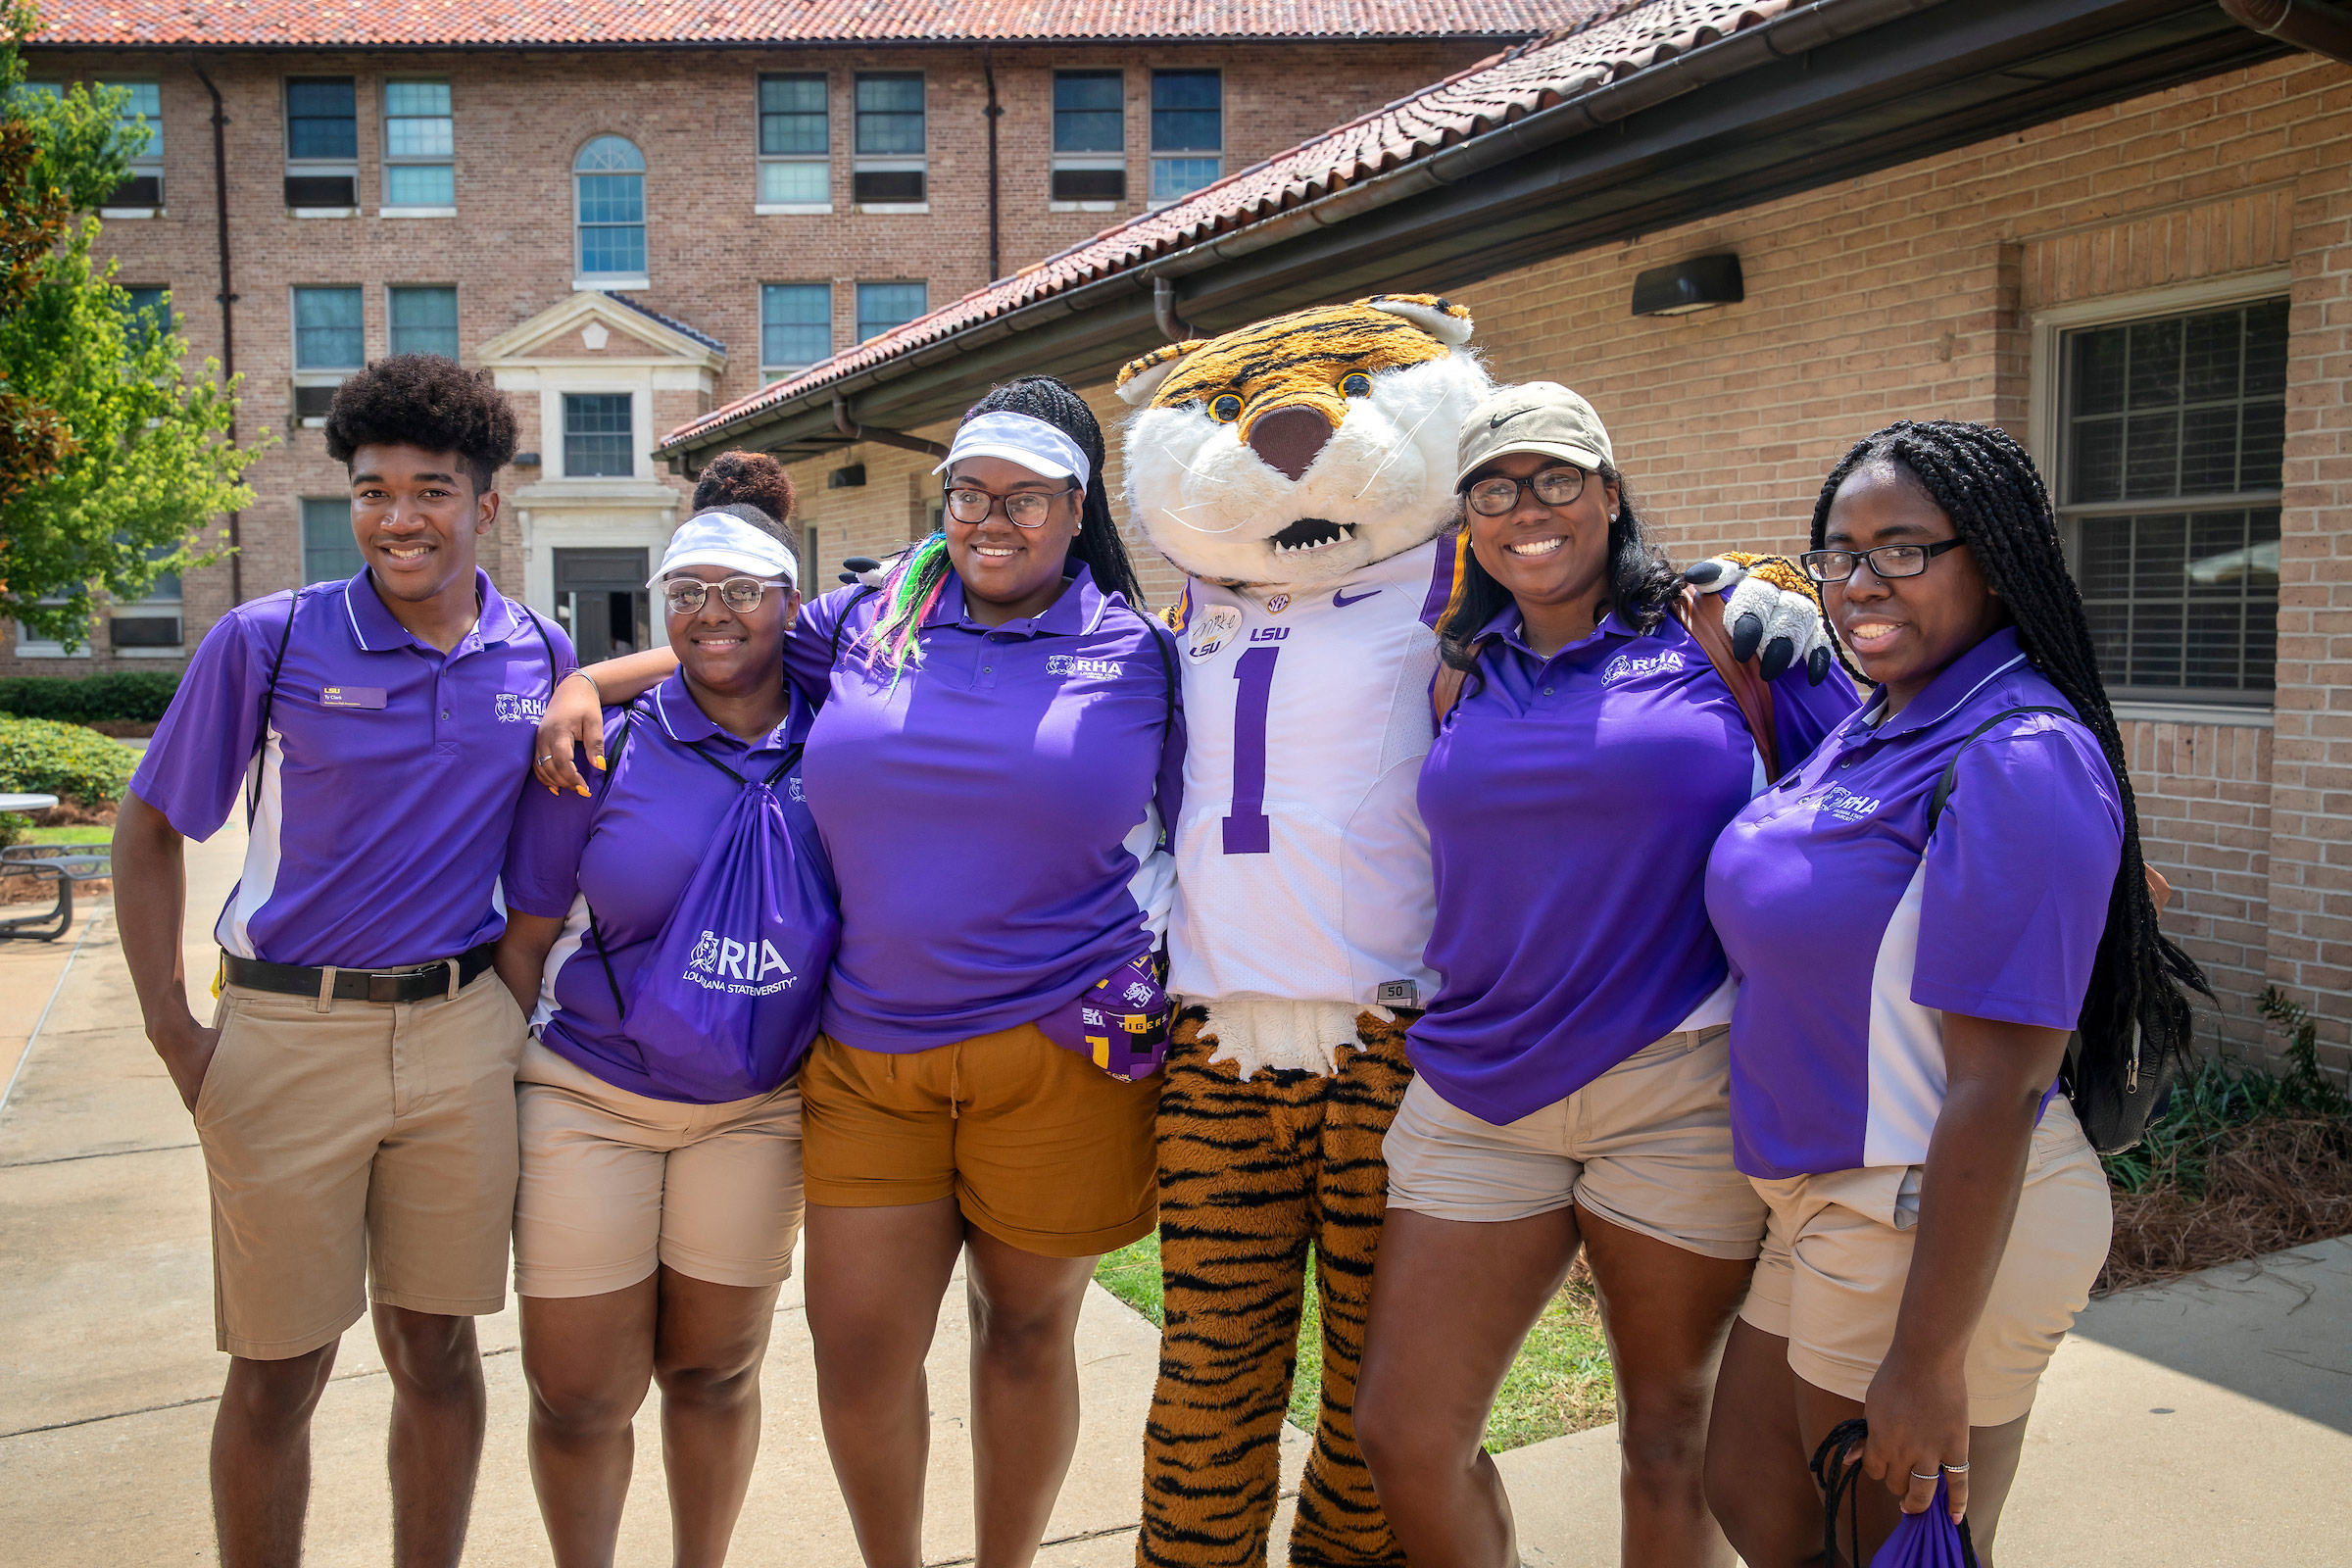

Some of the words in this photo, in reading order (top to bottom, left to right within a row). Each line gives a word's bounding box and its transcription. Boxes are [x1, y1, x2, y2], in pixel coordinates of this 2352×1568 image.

[1268, 594, 1290, 612] SEC
[1250, 627, 1291, 642] LSU
[1189, 640, 1222, 658] LSU
[1078, 660, 1123, 676] RHA
[1632, 651, 1684, 670] RHA
[1222, 647, 1280, 855] 1
[1838, 796, 1881, 815] RHA
[1388, 986, 1403, 997] 50
[1117, 1013, 1169, 1031] TIGERS
